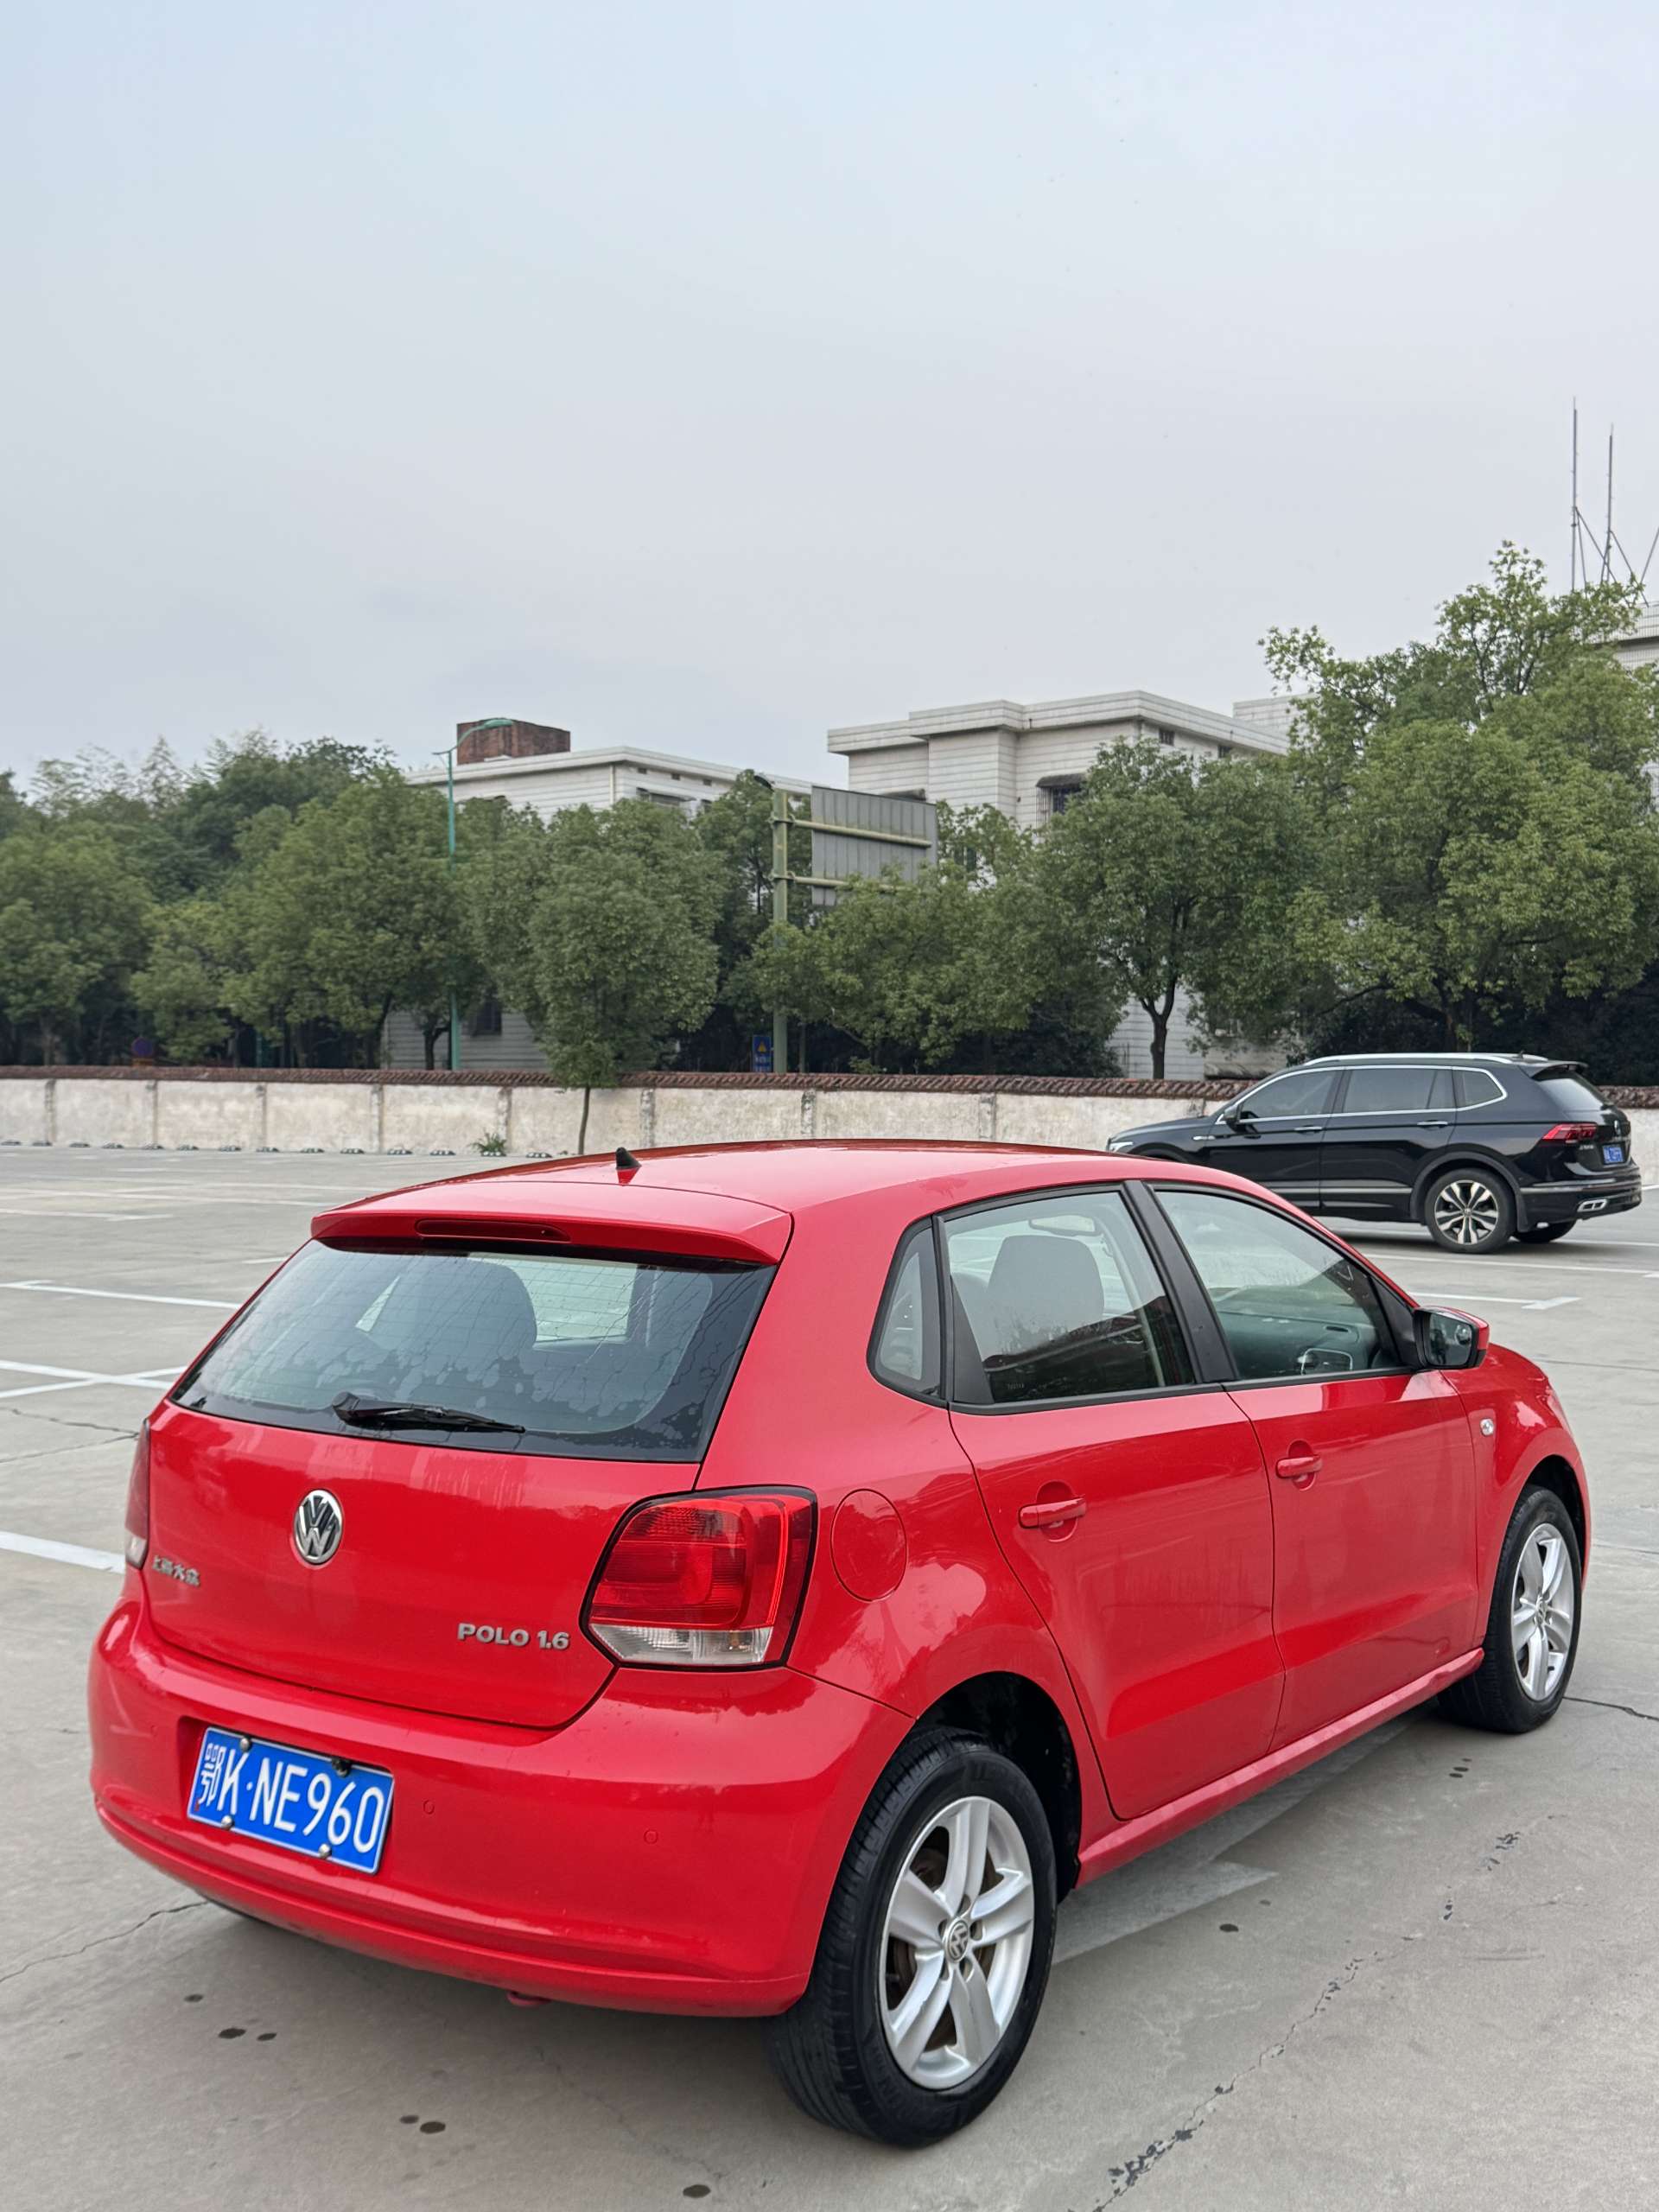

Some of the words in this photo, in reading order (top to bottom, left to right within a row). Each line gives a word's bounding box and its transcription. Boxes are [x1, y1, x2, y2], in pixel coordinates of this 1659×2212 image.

[295, 1490, 342, 1563] VW
[457, 1623, 530, 1647] POLO
[537, 1630, 569, 1649] 1.6
